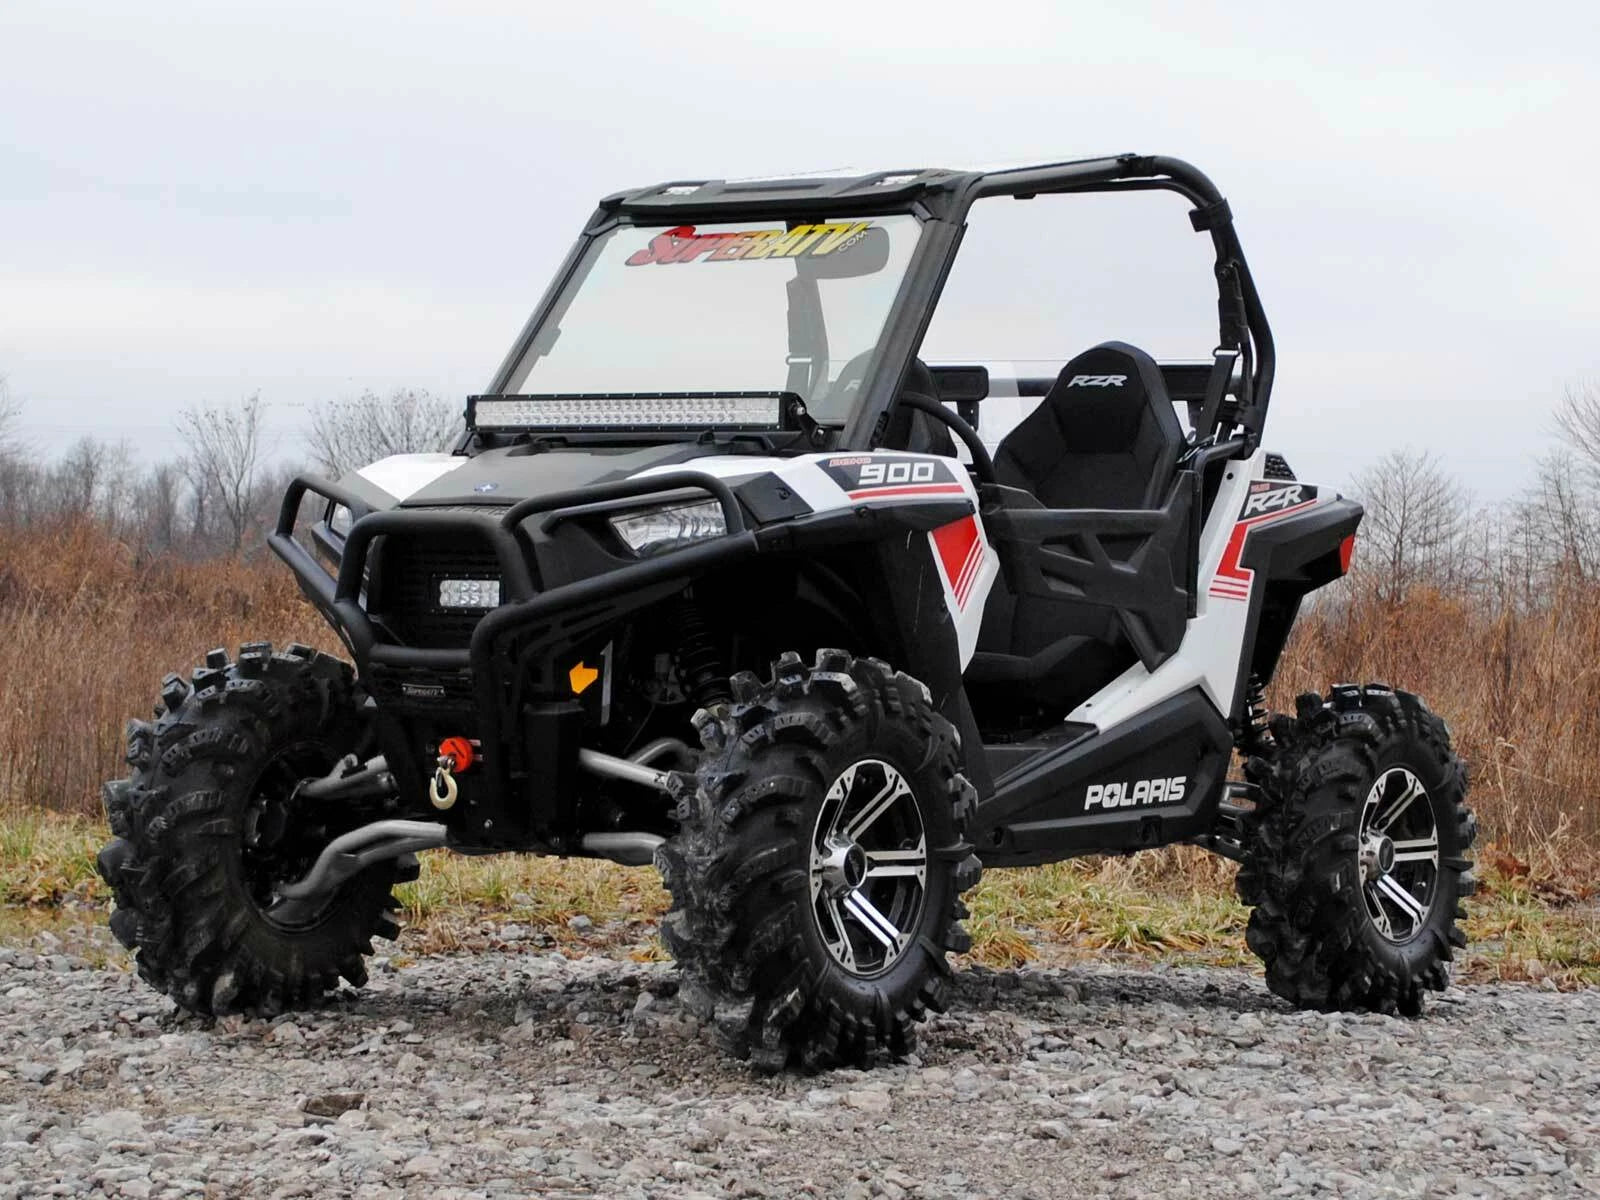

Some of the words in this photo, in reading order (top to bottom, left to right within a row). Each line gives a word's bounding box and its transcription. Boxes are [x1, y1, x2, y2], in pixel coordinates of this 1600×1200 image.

[1066, 374, 1128, 388] RZR
[858, 462, 935, 486] 900
[1243, 484, 1303, 517] RZR
[1084, 776, 1187, 810] POLARIS
